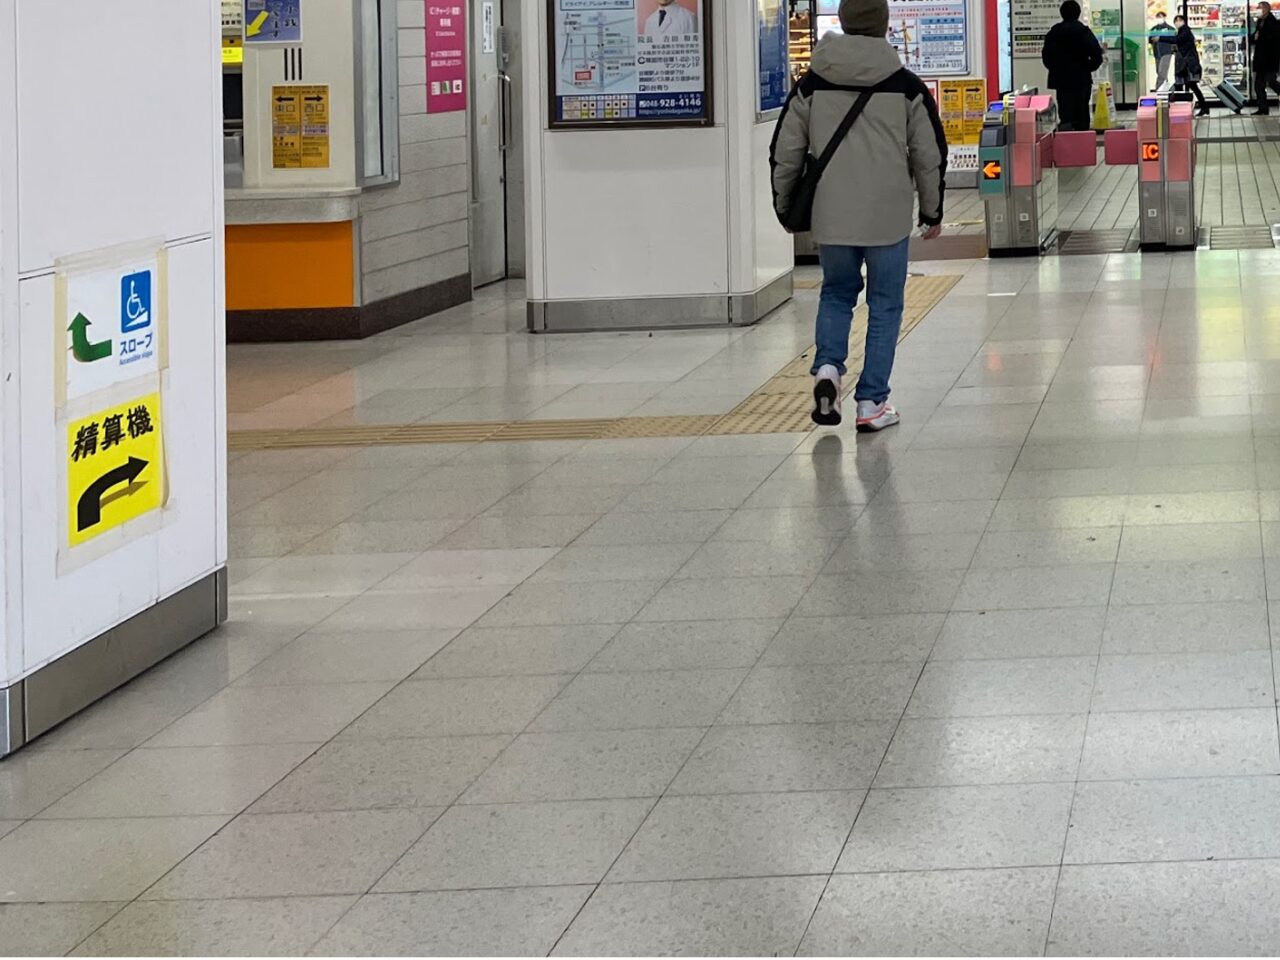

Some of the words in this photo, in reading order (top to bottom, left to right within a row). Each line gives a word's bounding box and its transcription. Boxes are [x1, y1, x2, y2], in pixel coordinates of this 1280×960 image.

[1142, 143, 1159, 160] IC
[120, 332, 153, 356] スロープ
[71, 405, 154, 463] 精算機
